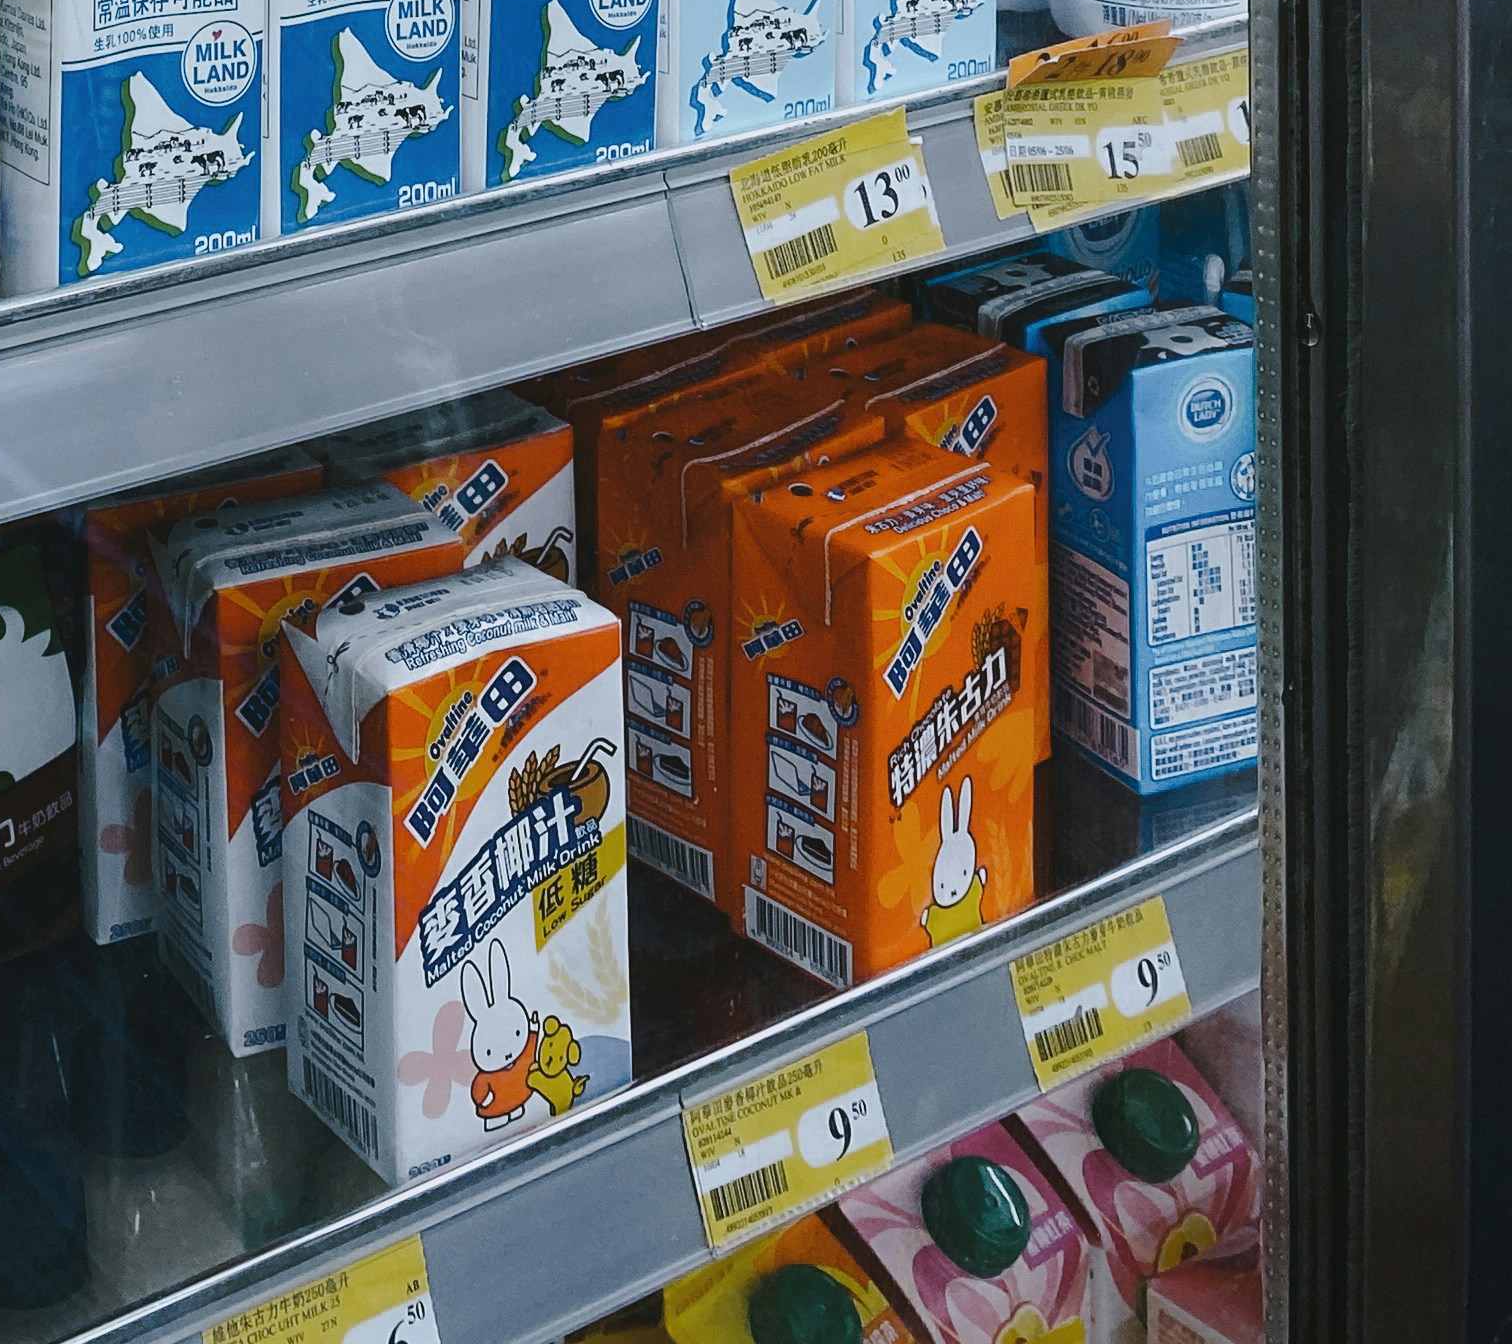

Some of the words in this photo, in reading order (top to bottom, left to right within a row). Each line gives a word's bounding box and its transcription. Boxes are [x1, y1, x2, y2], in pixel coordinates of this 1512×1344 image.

[195, 38, 247, 62] MILK
[394, 18, 448, 41] LAND
[192, 62, 250, 86] LAND
[742, 181, 788, 204] HOKKAIDO
[789, 173, 807, 185] LOW
[903, 560, 942, 622] Ovaltine
[406, 639, 467, 670] Refreshing
[467, 621, 512, 647] Coconut
[513, 616, 537, 633] milk
[427, 688, 475, 762] Ovaltine
[890, 646, 1007, 806] 特濃朱古力
[422, 792, 575, 967] 麥香椰汁
[427, 935, 474, 984] Malted
[474, 887, 524, 938] Coconut
[526, 863, 556, 891] Milk
[559, 834, 600, 866] Drink
[539, 851, 599, 922] 低糖
[543, 913, 566, 939] Low
[571, 876, 607, 910] Sugar
[1137, 958, 1159, 1007] 9
